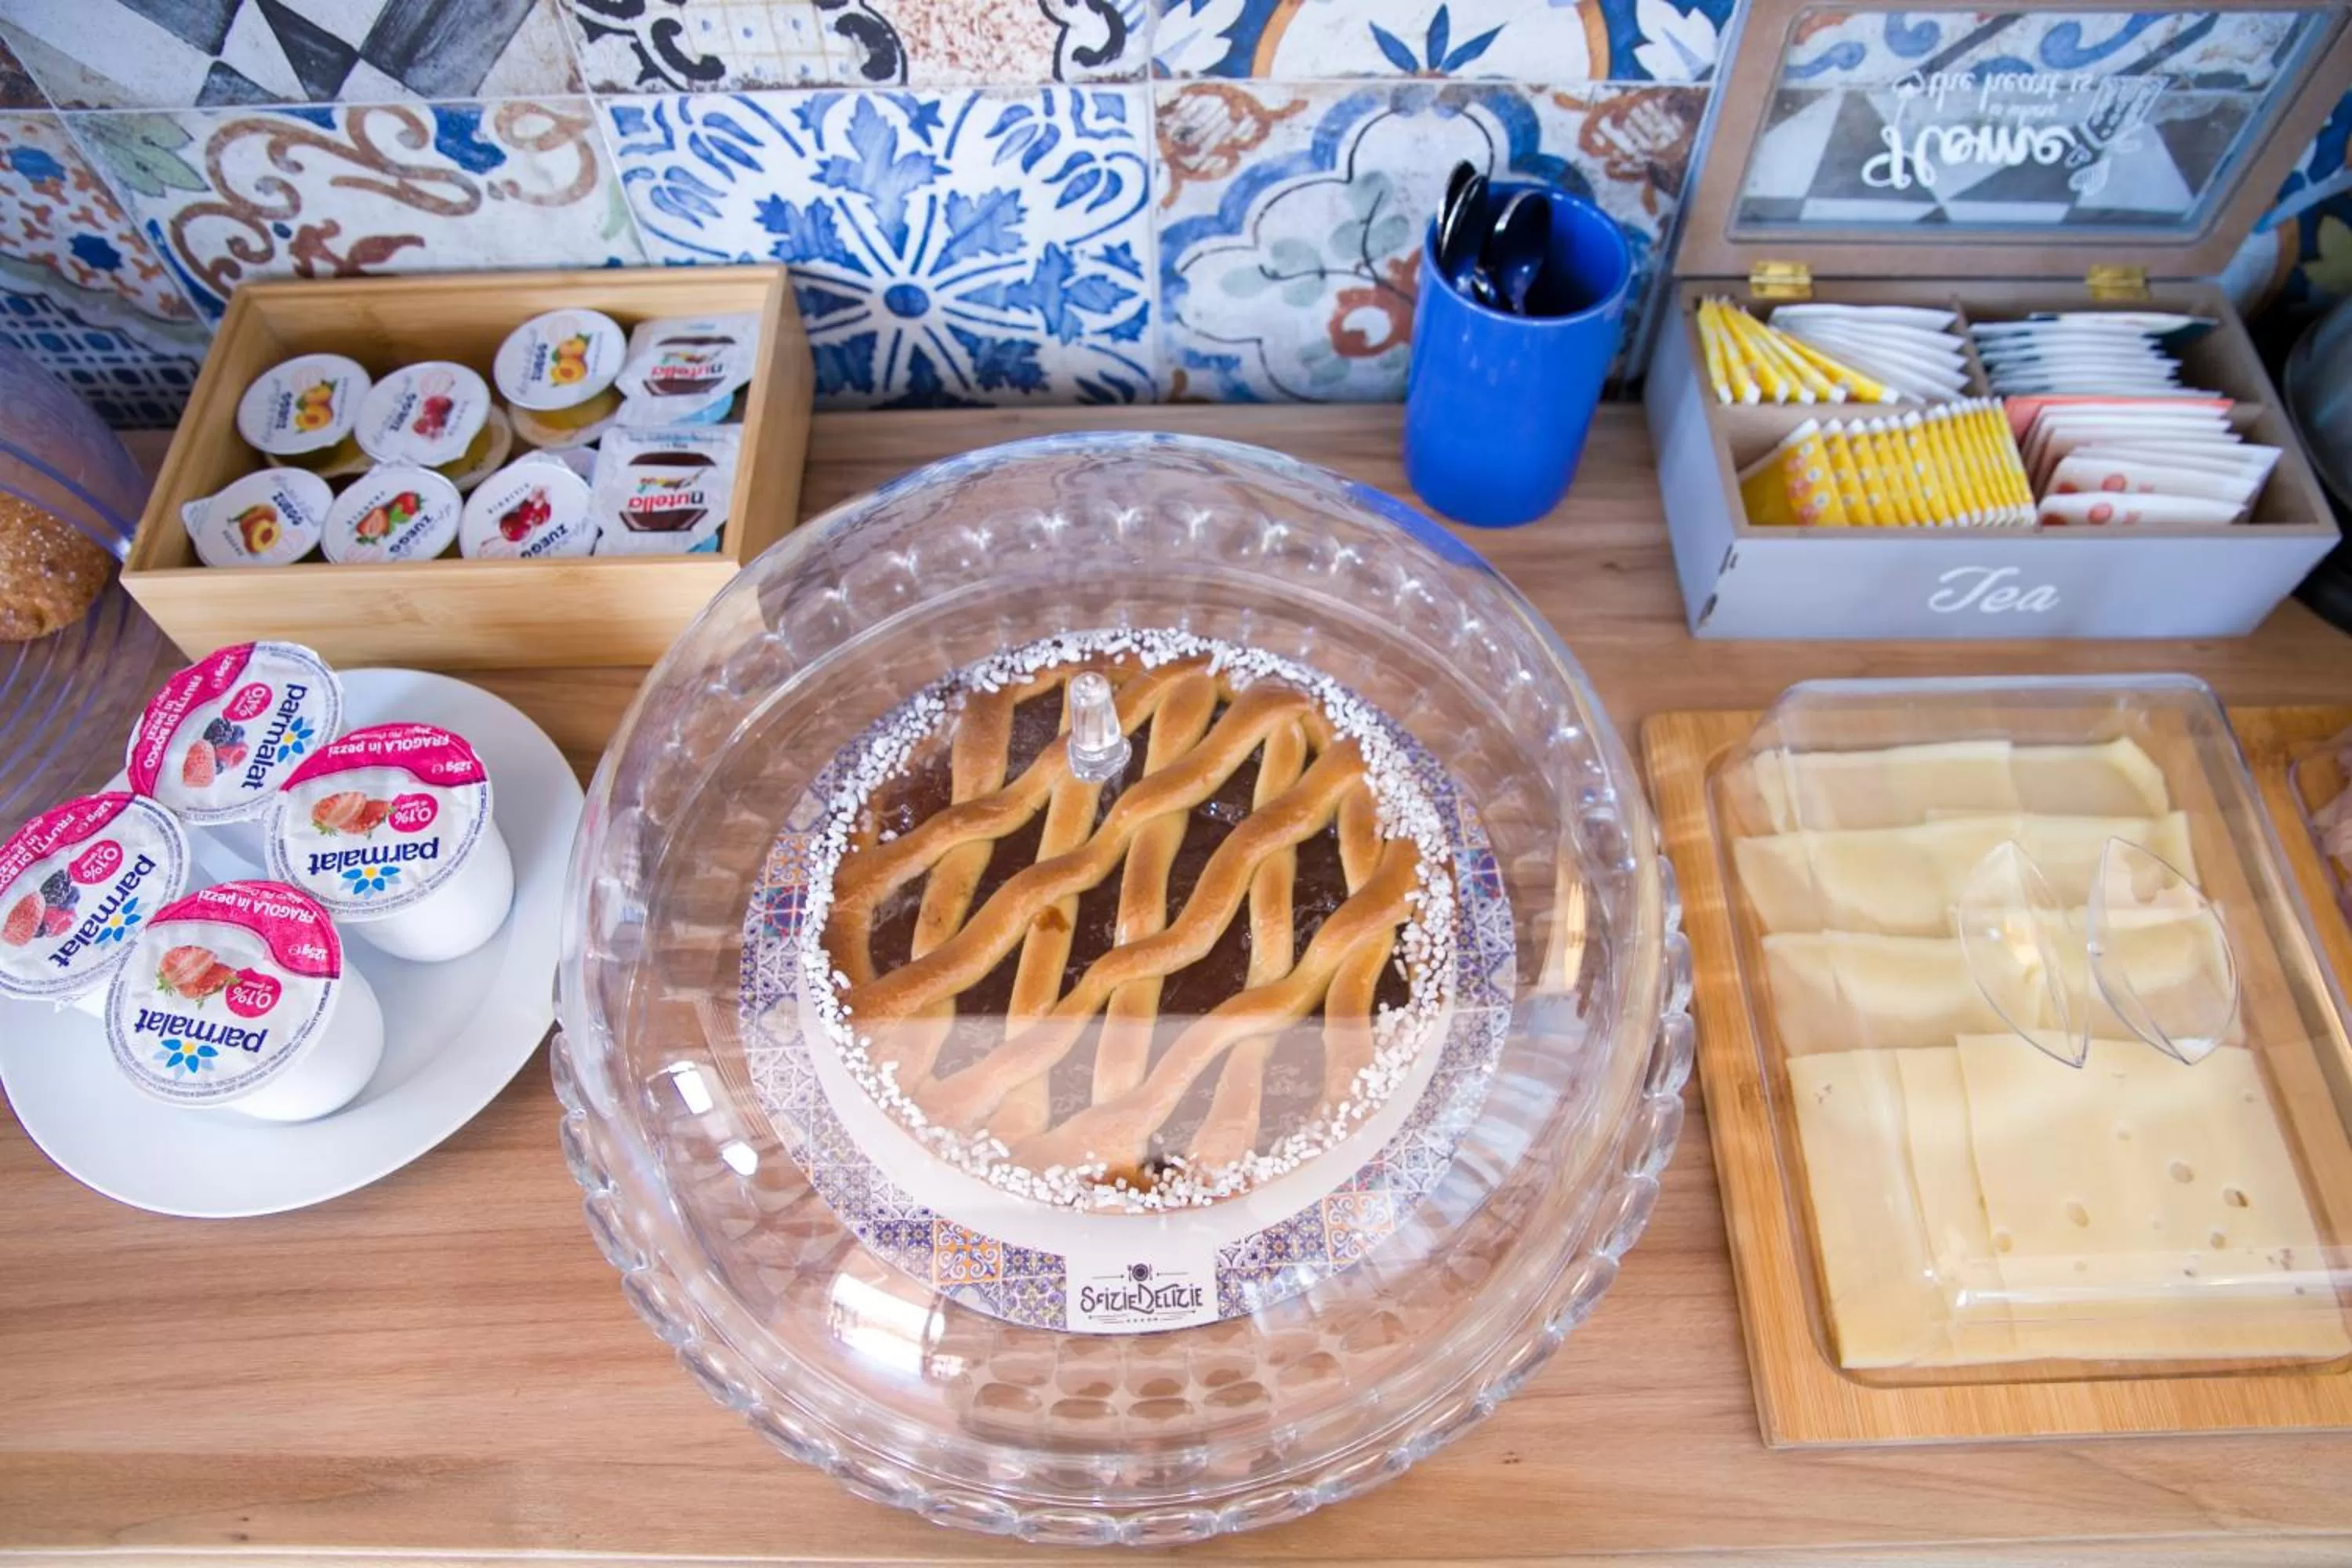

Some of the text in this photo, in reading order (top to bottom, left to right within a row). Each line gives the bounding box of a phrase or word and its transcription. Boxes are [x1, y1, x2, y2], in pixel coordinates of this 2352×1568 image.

[652, 363, 724, 378] nutella
[628, 491, 704, 514] nutella
[389, 516, 432, 553] ZUEGG
[1927, 565, 2061, 613] Tea
[241, 684, 308, 790] parmalat
[328, 735, 449, 758] FRAGOLA in pezzi
[34, 815, 75, 853] FRUTTI
[307, 837, 439, 876] parmalat
[49, 854, 156, 967] parmalat
[198, 890, 237, 905] pezzi
[238, 896, 252, 909] in
[254, 902, 316, 924] FRAGOLA
[134, 1008, 269, 1053] parmalat
